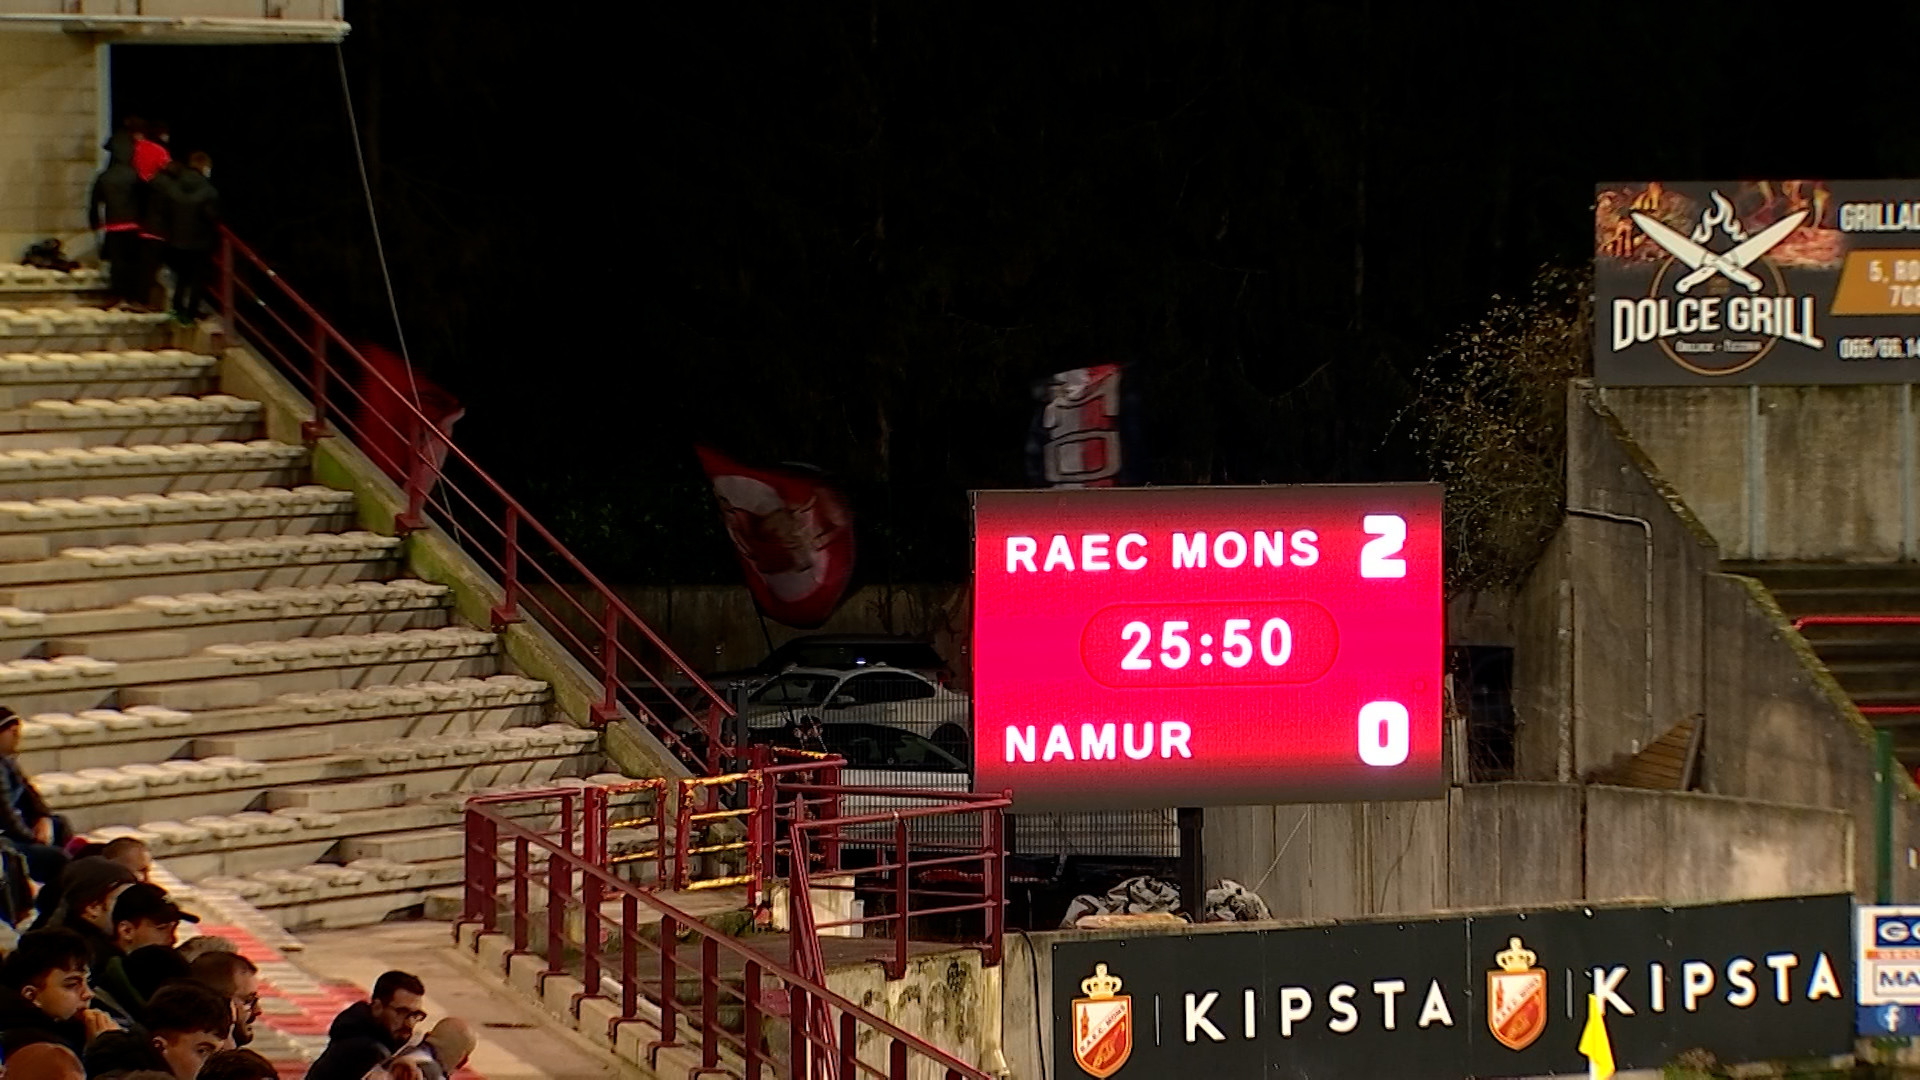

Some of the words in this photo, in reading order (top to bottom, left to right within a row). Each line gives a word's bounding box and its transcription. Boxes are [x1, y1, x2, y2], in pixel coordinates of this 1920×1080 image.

[1613, 297, 1722, 351] DOLCE
[1726, 296, 1824, 349] GRILL
[1006, 533, 1149, 573] RAEC
[1172, 530, 1320, 569] MONS
[1360, 514, 1406, 578] 2
[1120, 617, 1293, 670] 25:50
[1005, 721, 1192, 762] NAMUR
[1358, 700, 1409, 767] 0
[1185, 979, 1454, 1043] KIPSTA
[1593, 952, 1841, 1016] KIPSTA
